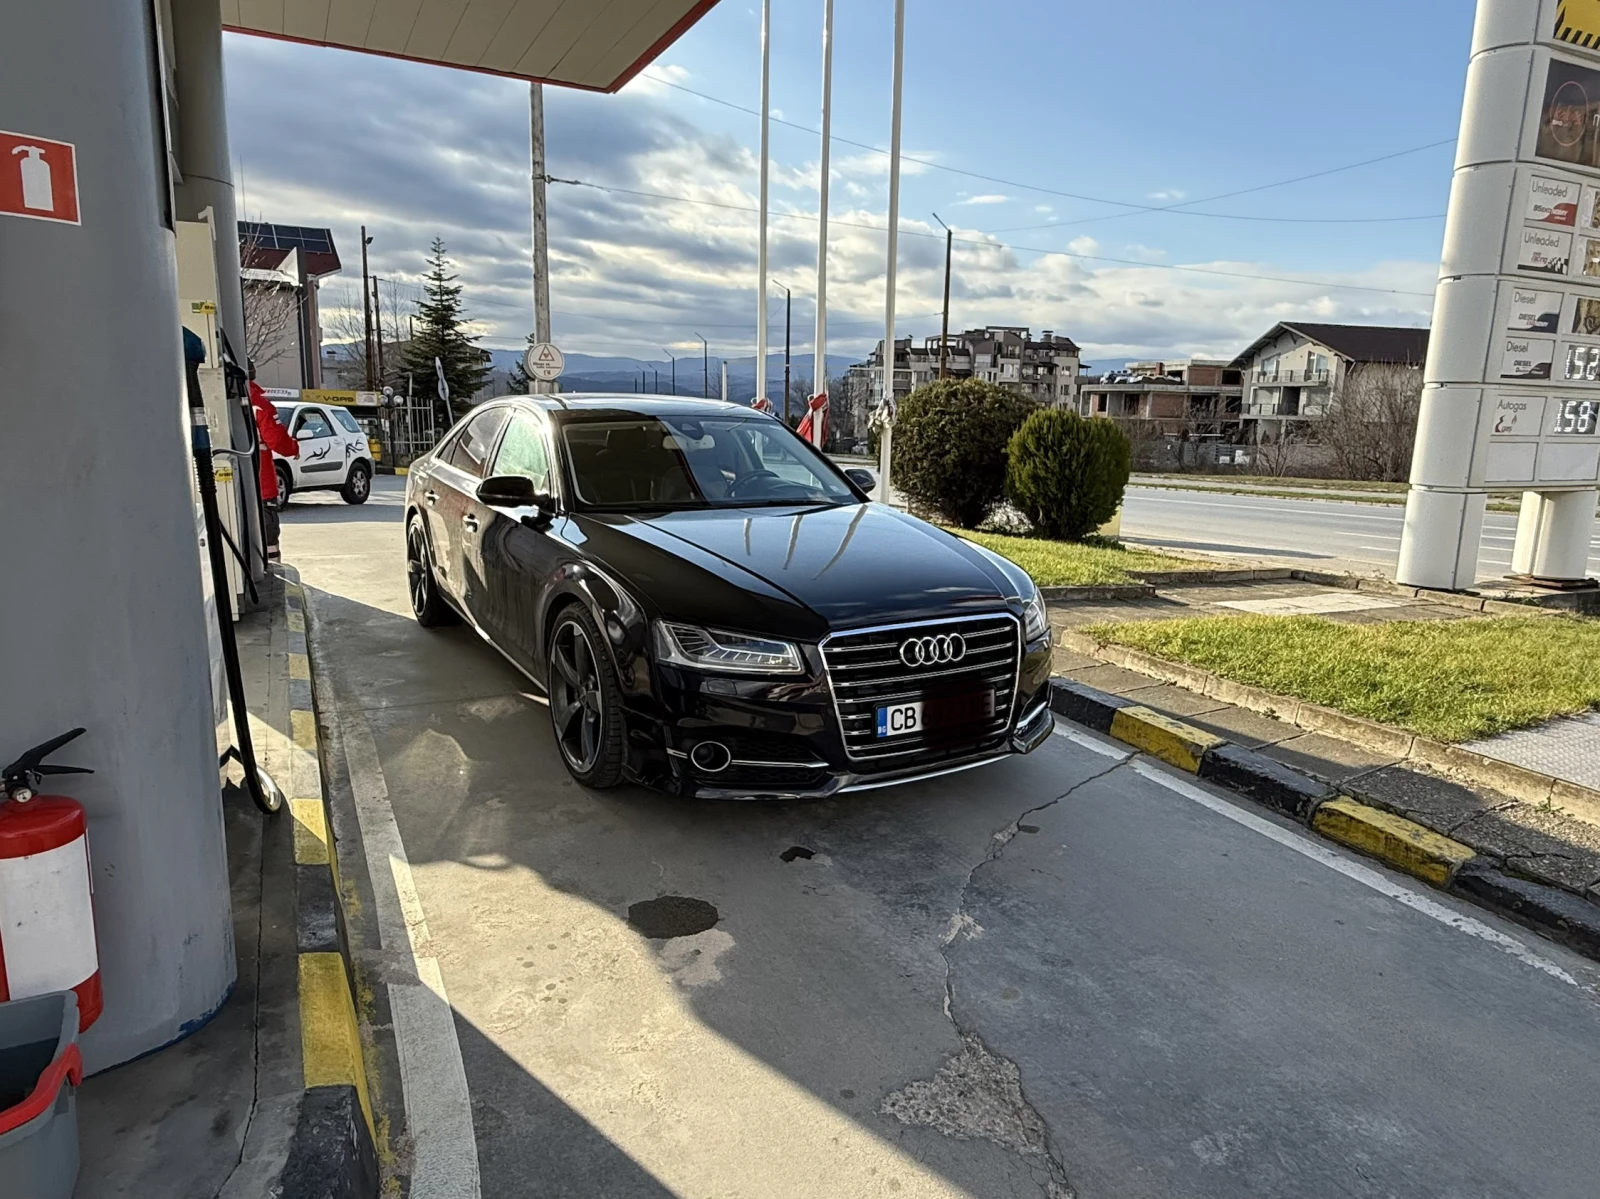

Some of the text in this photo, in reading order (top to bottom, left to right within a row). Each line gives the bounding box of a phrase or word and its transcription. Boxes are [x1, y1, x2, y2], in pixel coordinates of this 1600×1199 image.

[1531, 181, 1568, 198] Unleaded
[197, 205, 217, 241] 1
[1524, 232, 1560, 248] Unleaded
[1514, 291, 1537, 304] Diesel
[1506, 341, 1529, 353] Diesel
[1497, 399, 1527, 413] Autogas
[891, 706, 917, 731] CB
